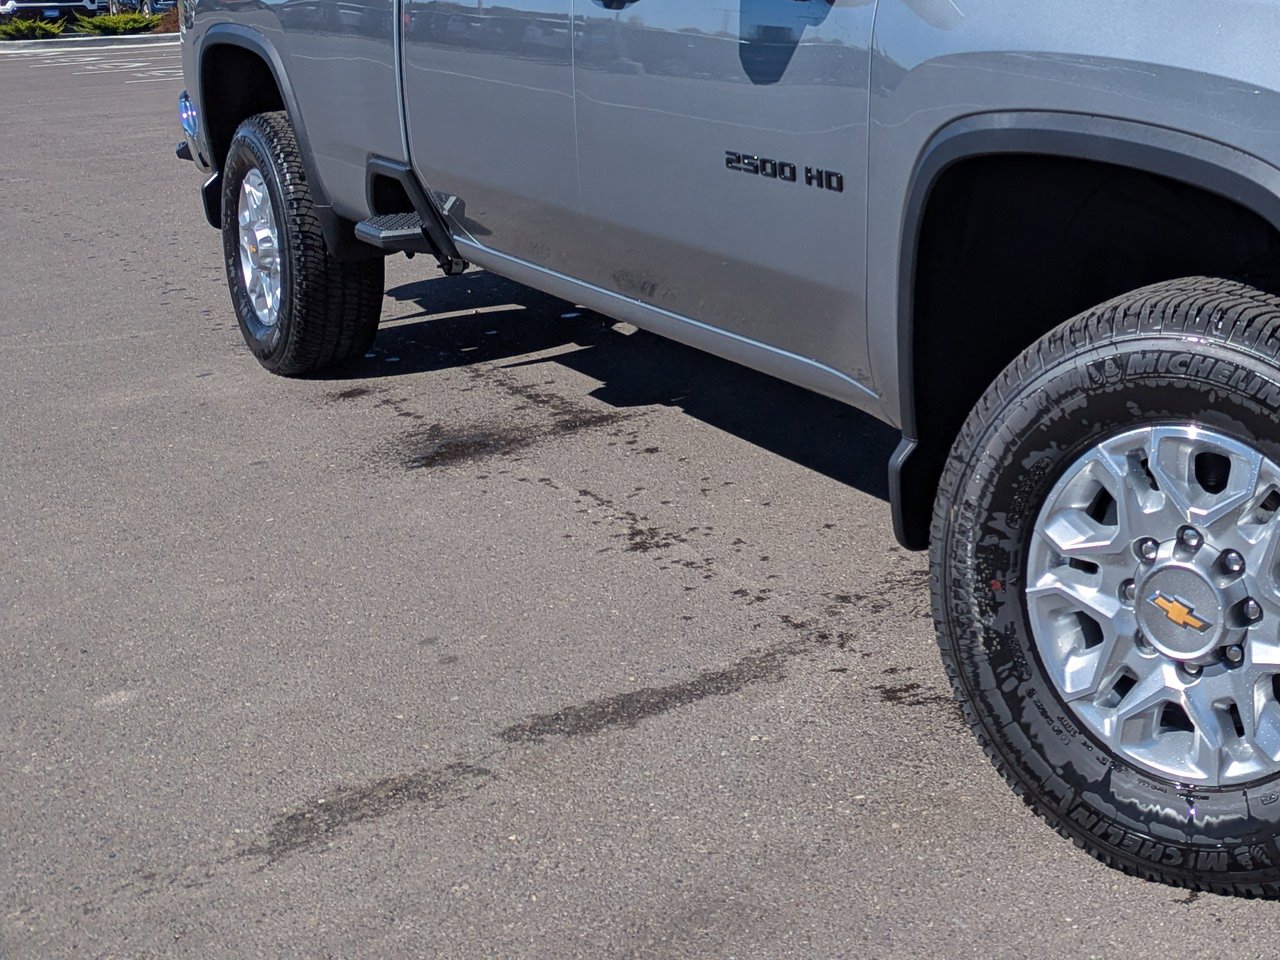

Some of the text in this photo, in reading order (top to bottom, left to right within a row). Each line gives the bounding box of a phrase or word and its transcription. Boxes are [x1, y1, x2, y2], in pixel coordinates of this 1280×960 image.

[725, 150, 844, 193] 2500 HD
[1069, 807, 1229, 872] MICHELIN
